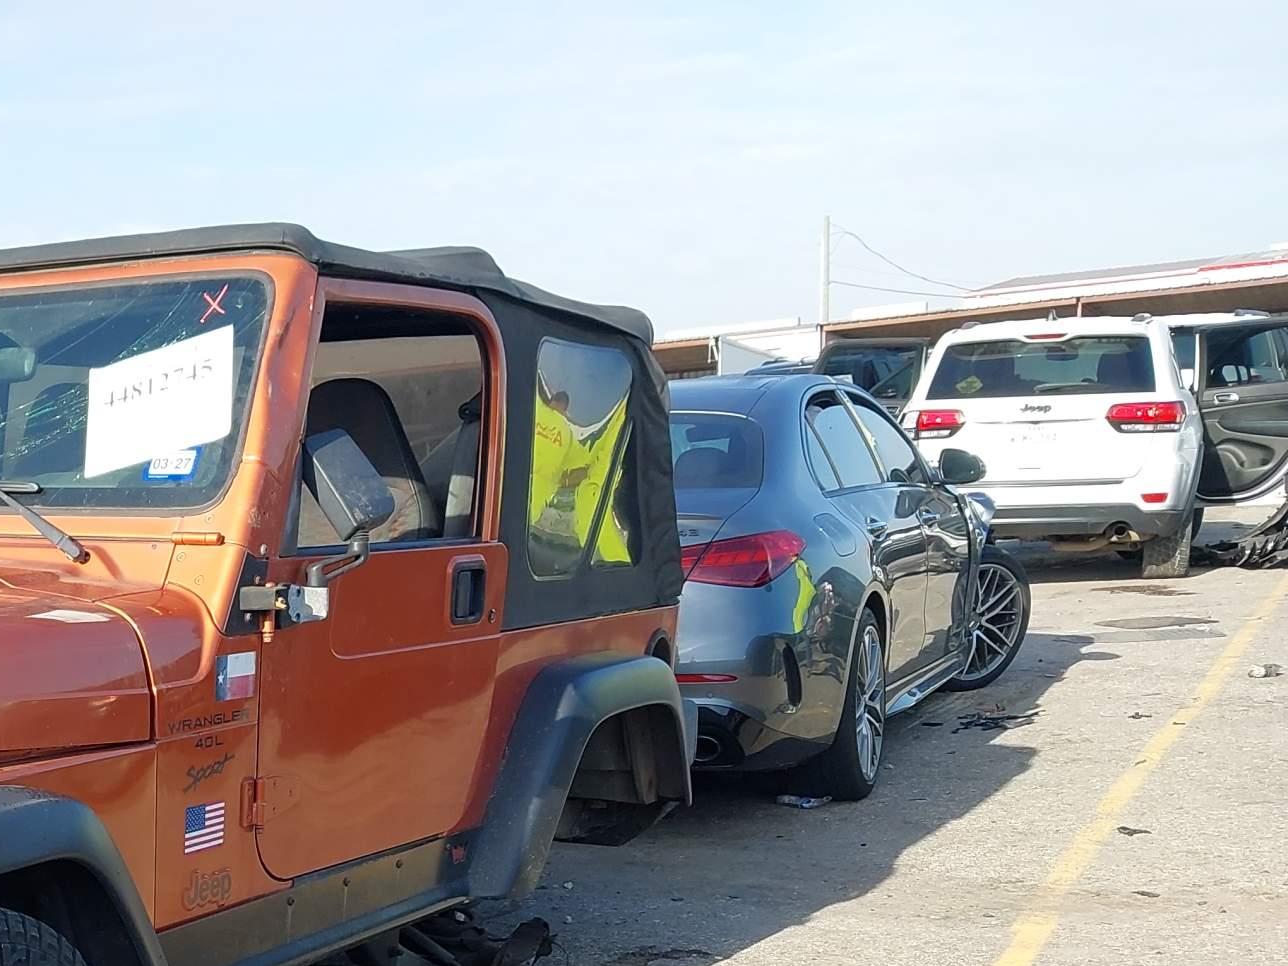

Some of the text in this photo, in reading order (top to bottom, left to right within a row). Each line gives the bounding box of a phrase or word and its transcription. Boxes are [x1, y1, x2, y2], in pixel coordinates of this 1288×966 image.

[1019, 403, 1052, 414] Jeep
[168, 708, 250, 735] WRANGLER
[183, 869, 232, 910] Jeep
